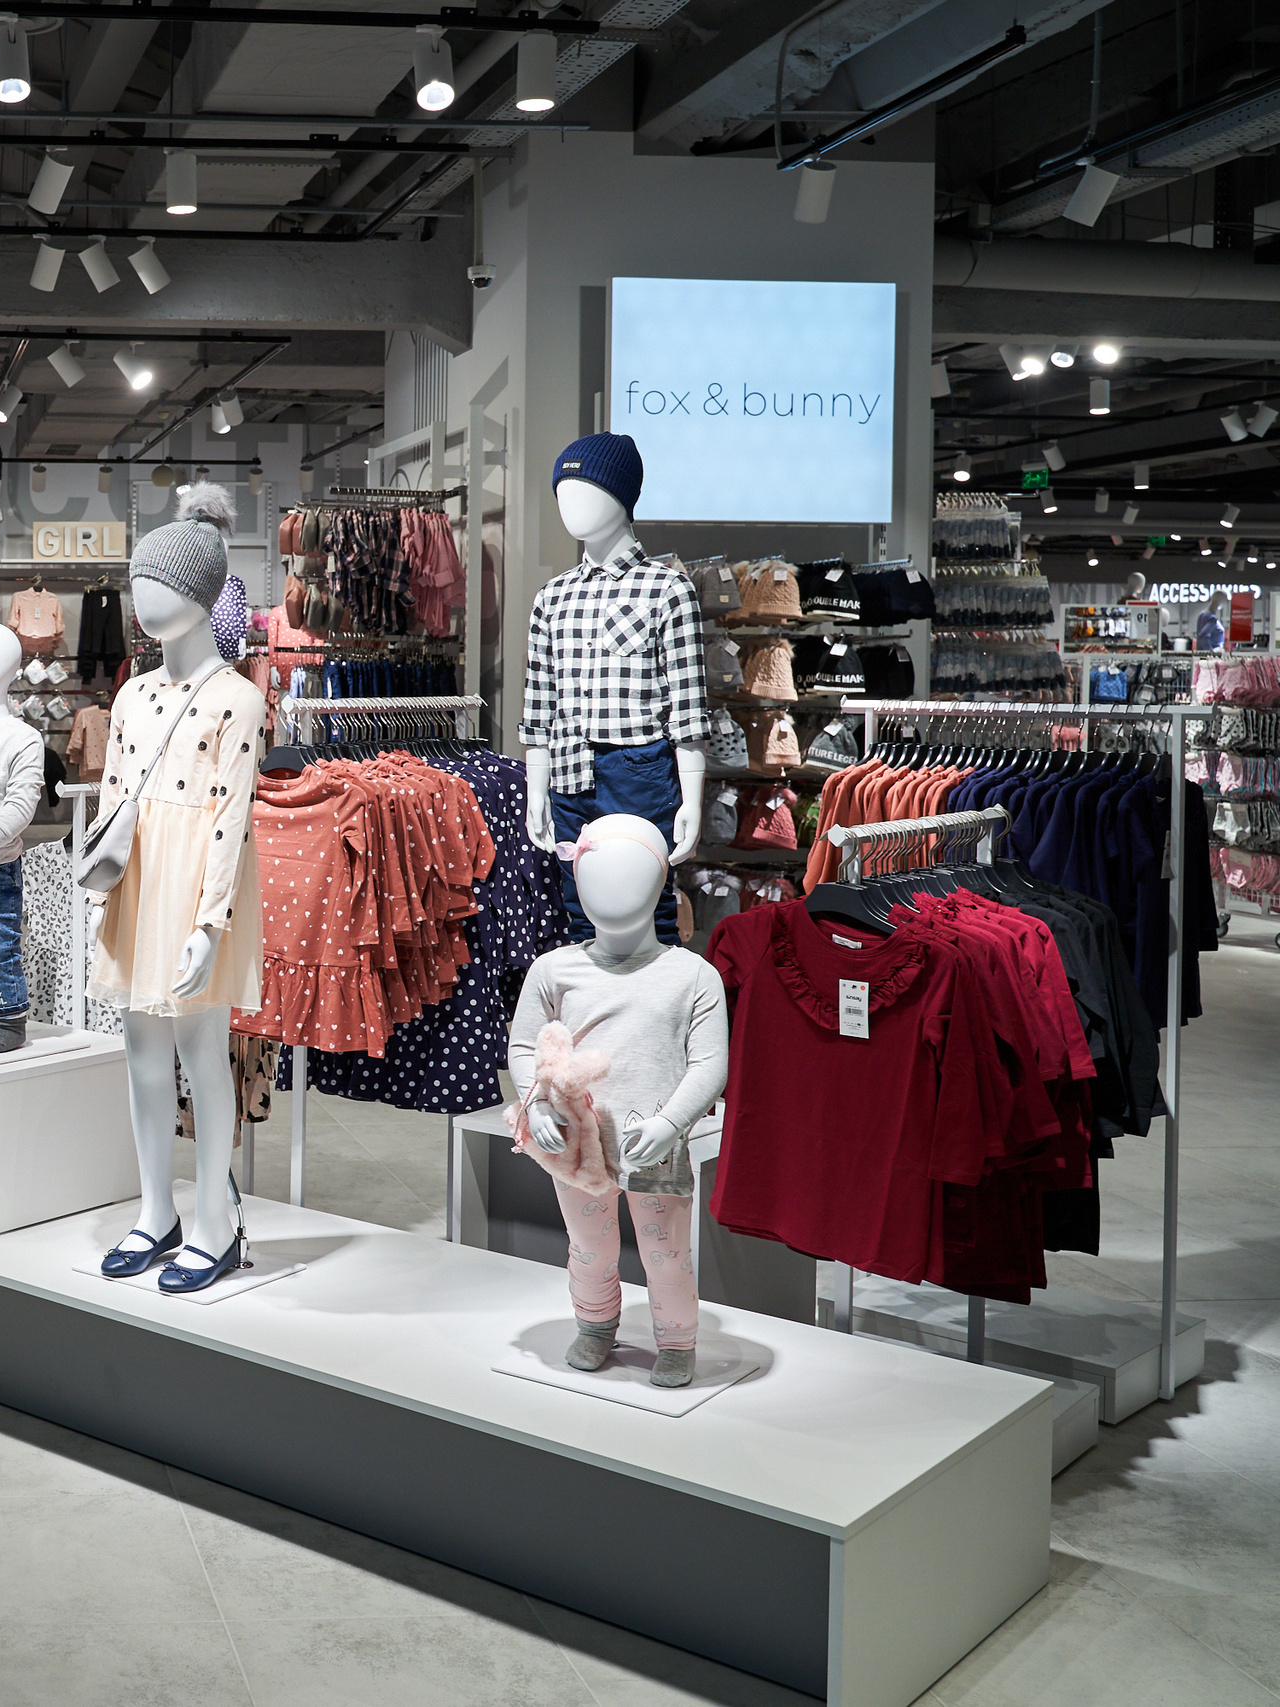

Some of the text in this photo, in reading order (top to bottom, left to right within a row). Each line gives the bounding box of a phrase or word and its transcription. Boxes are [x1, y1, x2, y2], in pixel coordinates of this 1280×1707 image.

[626, 380, 881, 425] fox & bunny
[36, 526, 122, 557] GIRL
